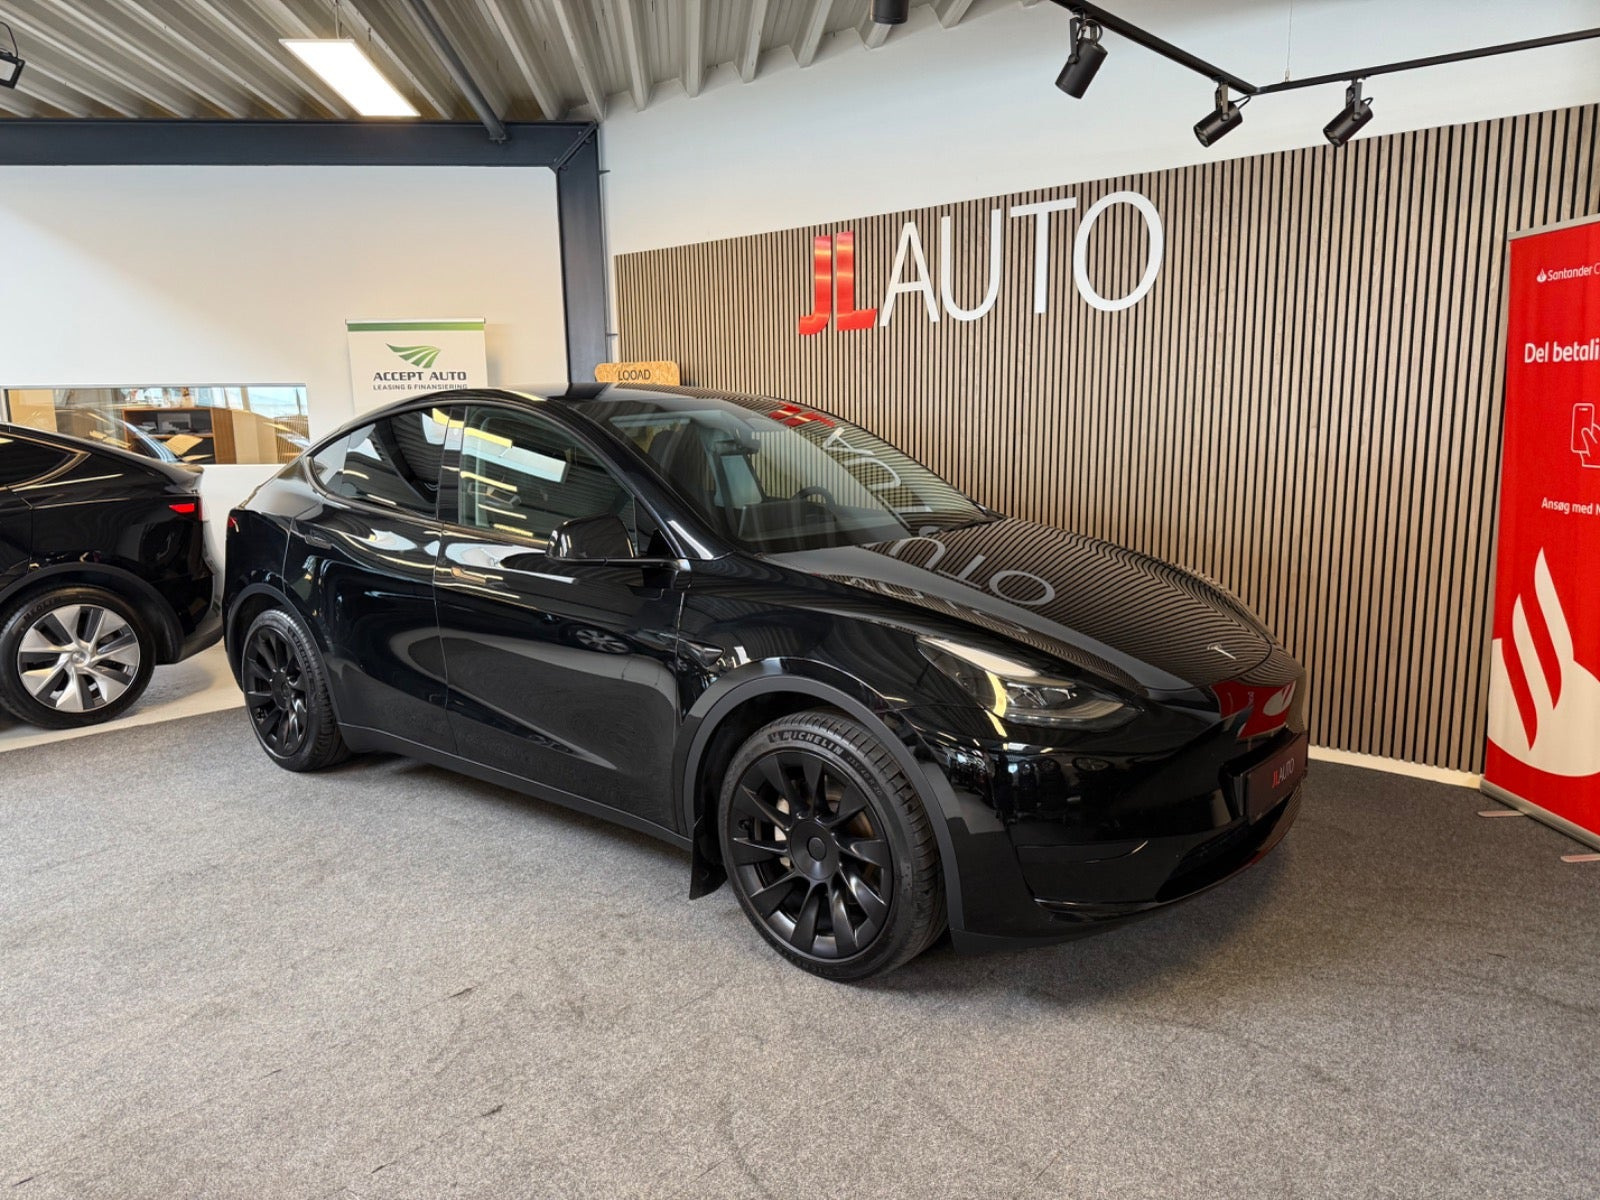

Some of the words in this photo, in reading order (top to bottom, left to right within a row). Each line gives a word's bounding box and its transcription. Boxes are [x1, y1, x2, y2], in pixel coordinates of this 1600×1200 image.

[1547, 265, 1593, 281] Santander
[1524, 341, 1549, 363] Del
[1552, 337, 1600, 362] betali
[373, 371, 424, 381] ACCEPT
[429, 371, 467, 381] AUTO
[618, 369, 651, 381] LOOAD
[414, 383, 468, 391] FINANSIERING
[1541, 496, 1570, 515] Ansøg
[1572, 503, 1593, 515] med
[782, 730, 844, 756] MICHELIN
